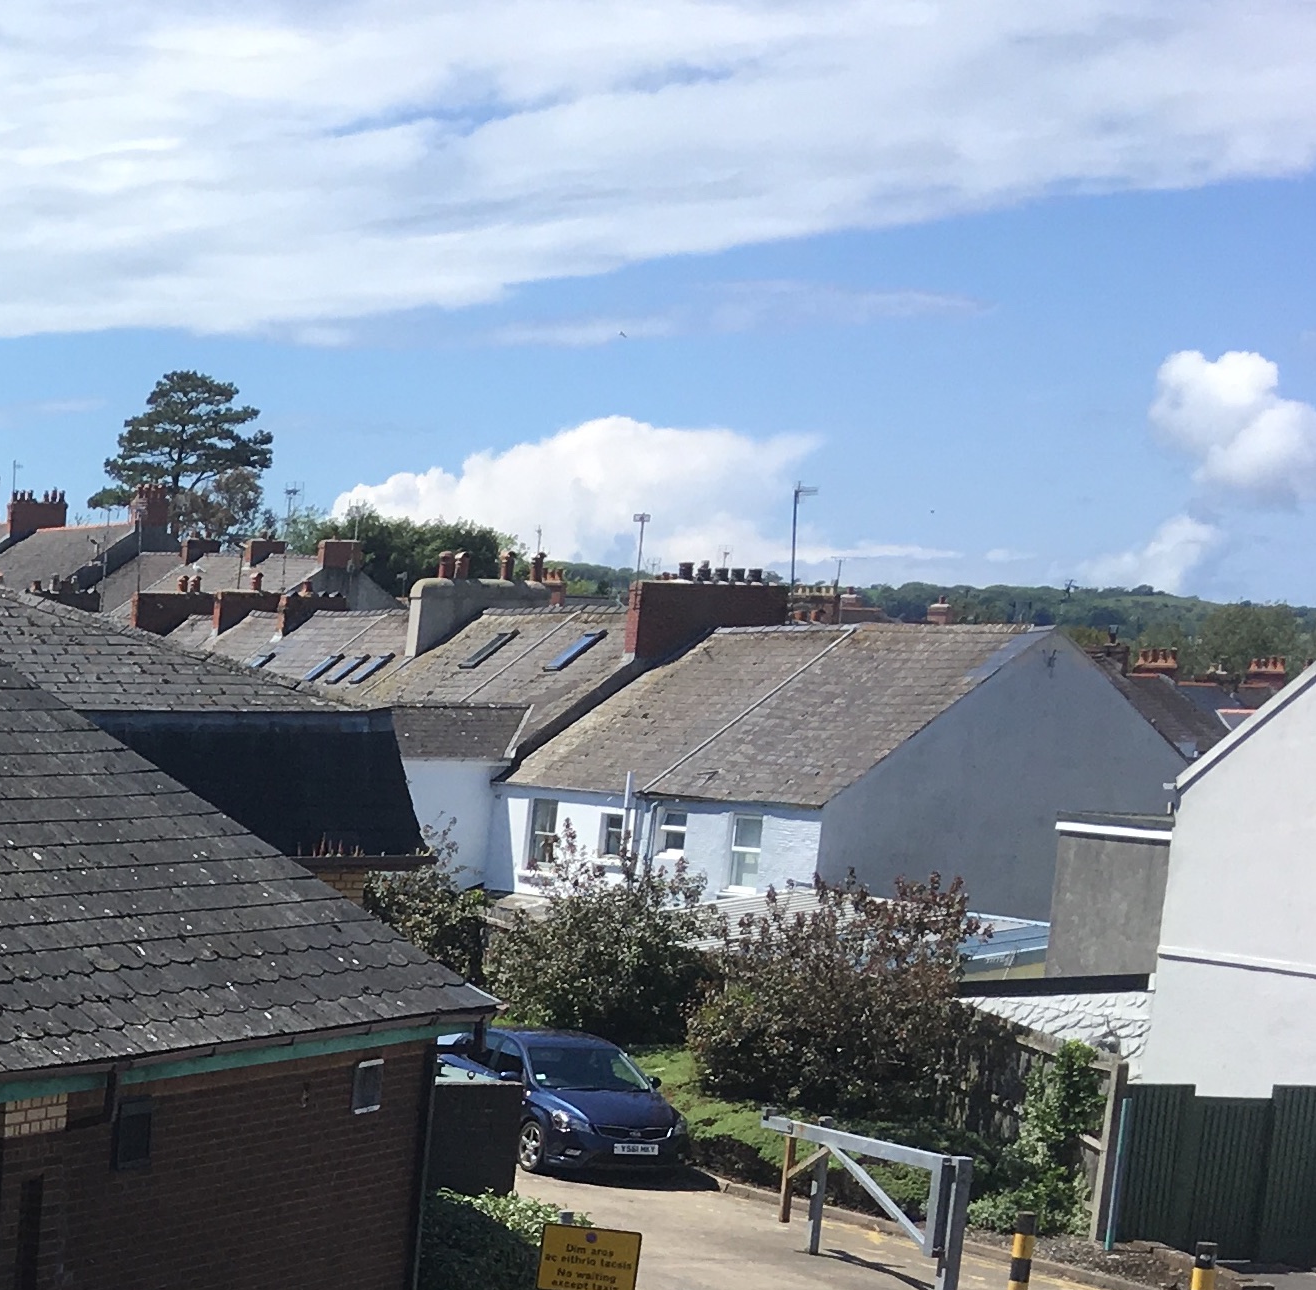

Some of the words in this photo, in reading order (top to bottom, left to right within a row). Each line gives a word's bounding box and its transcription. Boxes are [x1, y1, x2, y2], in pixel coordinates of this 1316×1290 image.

[566, 1243, 586, 1254] Dim
[591, 1247, 614, 1258] aros
[545, 1253, 557, 1262] ac
[561, 1255, 596, 1266] eithrio
[600, 1258, 632, 1270] tacsis
[557, 1267, 572, 1278] No
[576, 1271, 616, 1284] waiting
[552, 1280, 588, 1290] except
